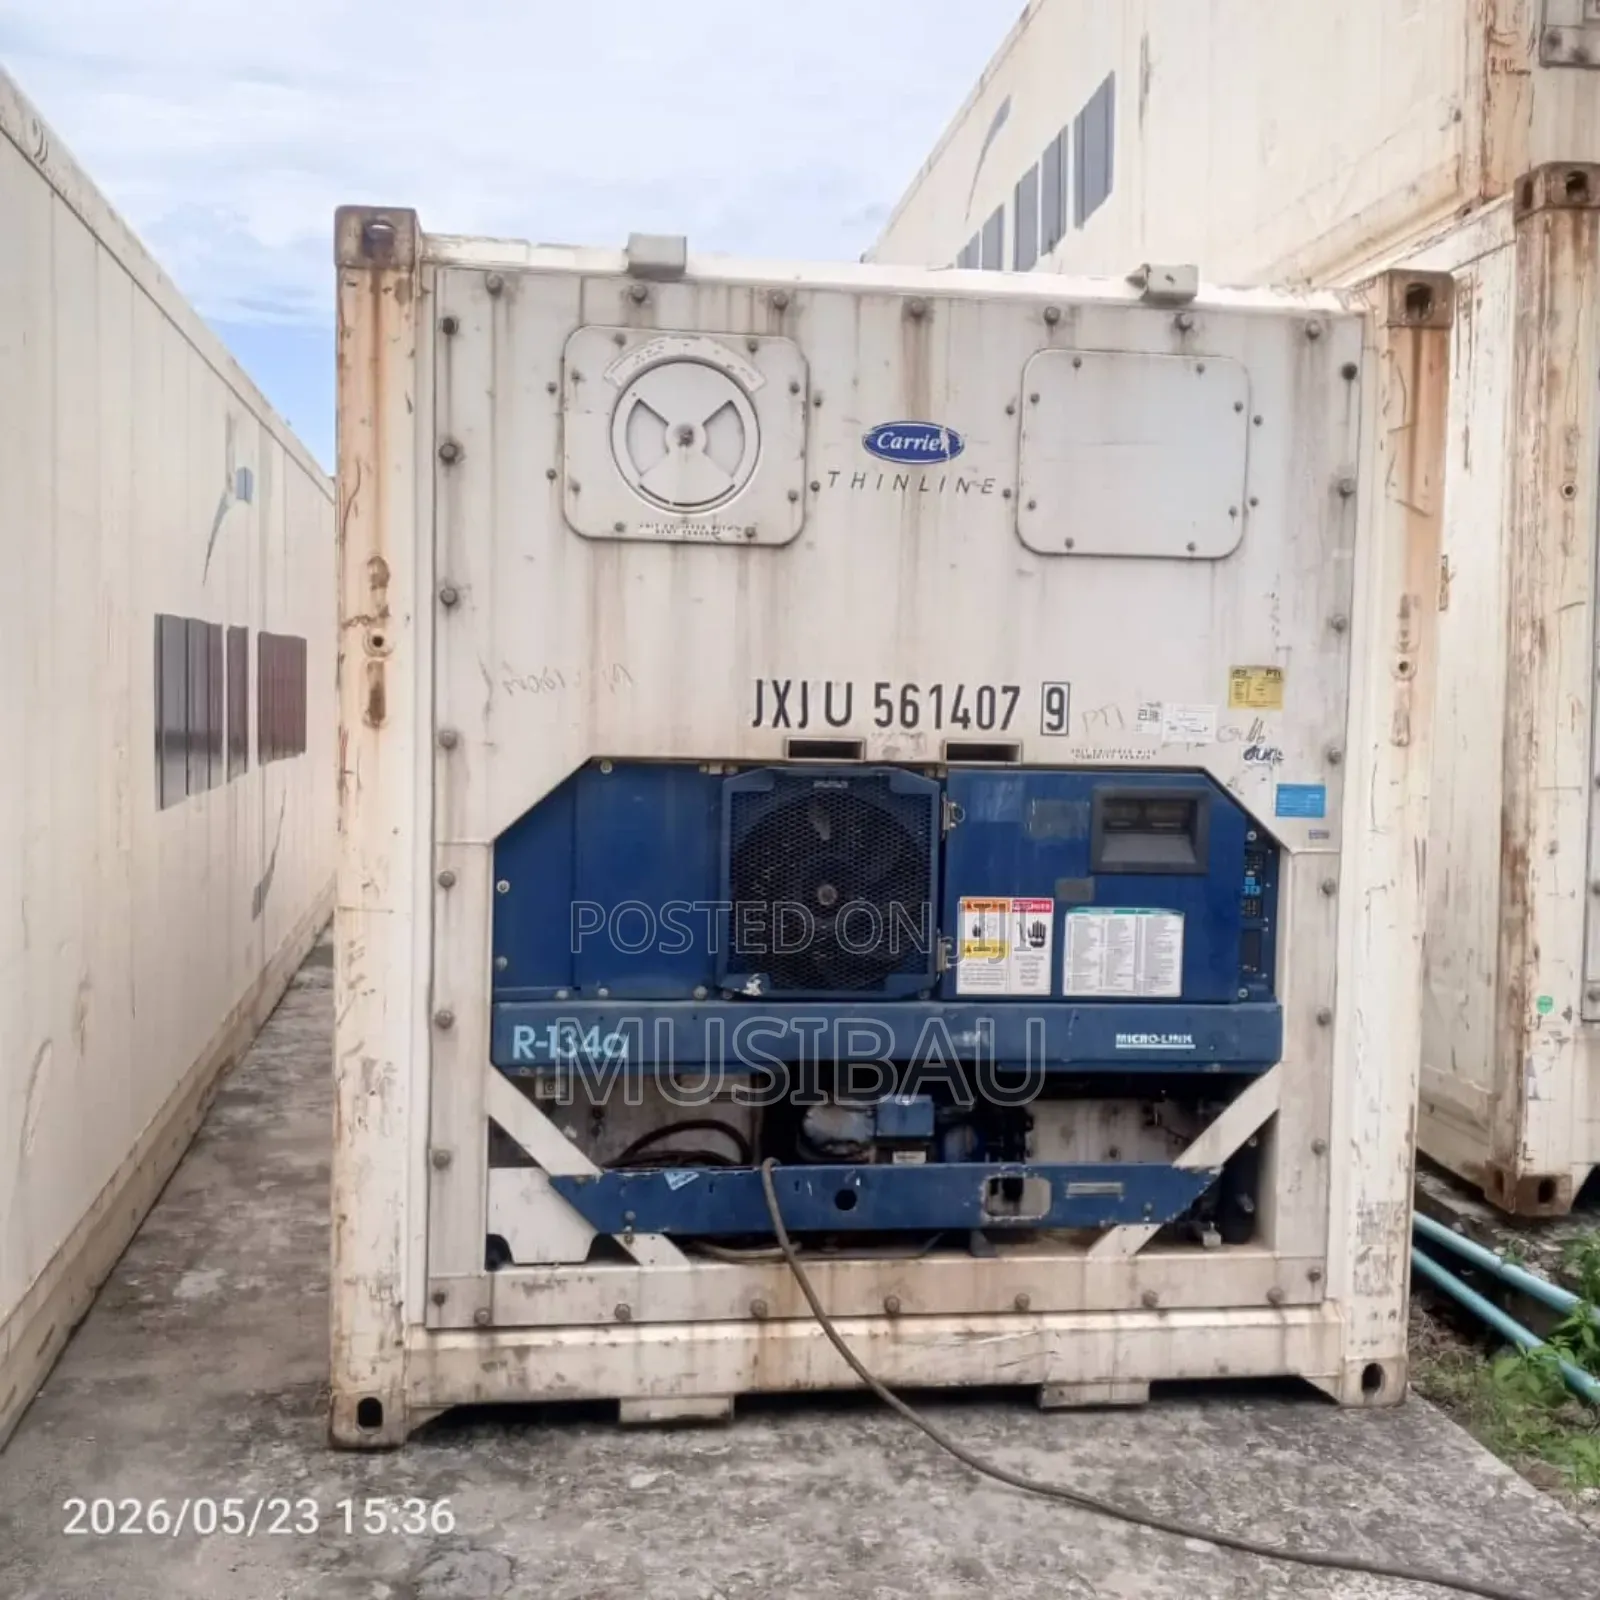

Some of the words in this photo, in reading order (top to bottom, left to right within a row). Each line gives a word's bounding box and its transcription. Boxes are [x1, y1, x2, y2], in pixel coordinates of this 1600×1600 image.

[828, 470, 997, 494] THINLINE
[751, 678, 853, 729] JXJU
[874, 681, 1021, 731] 561407
[1045, 686, 1066, 732] 9
[513, 1025, 629, 1059] R-134a
[1115, 1033, 1194, 1045] MICRO-LINK
